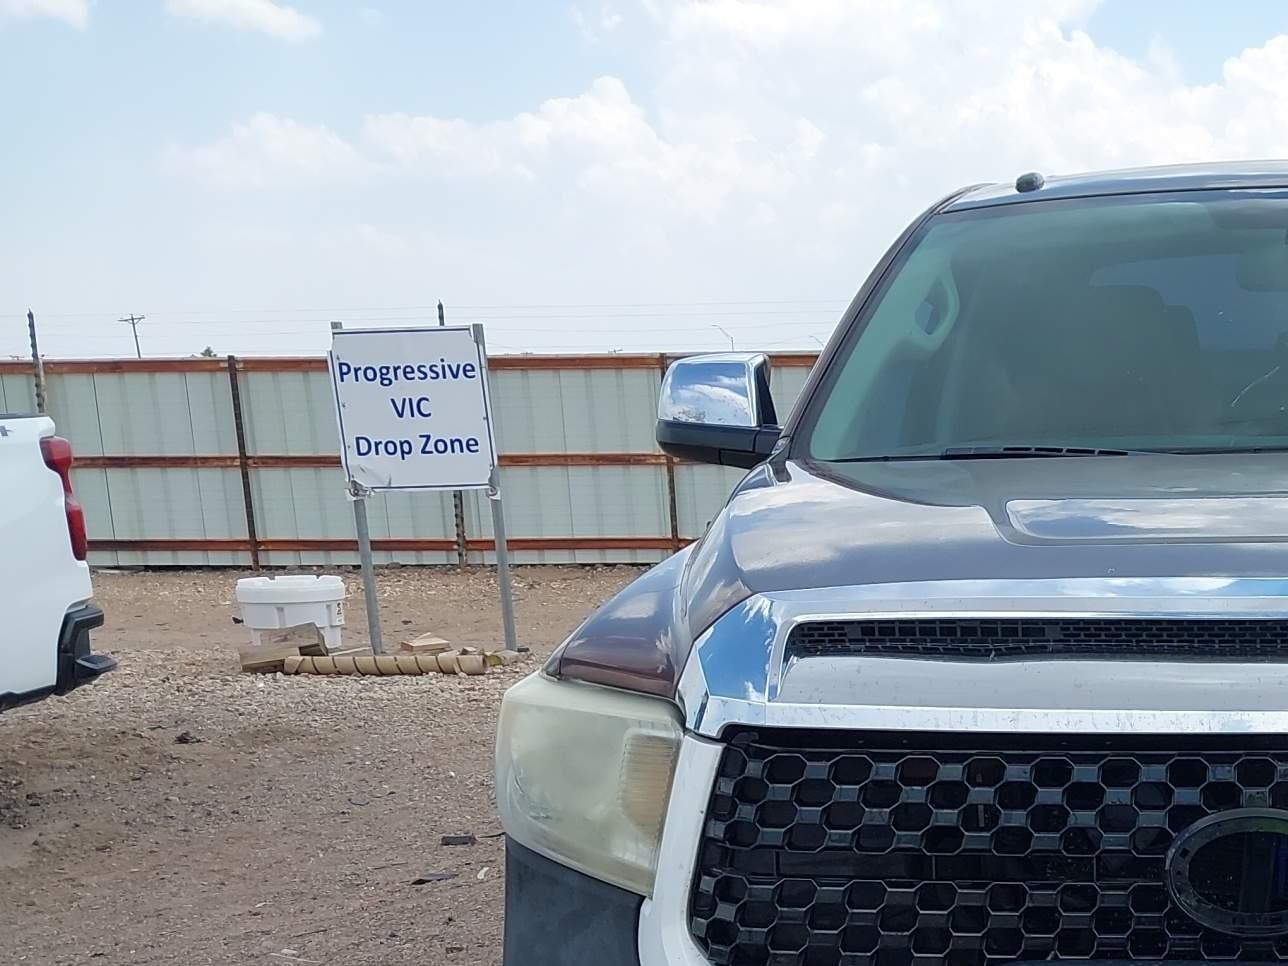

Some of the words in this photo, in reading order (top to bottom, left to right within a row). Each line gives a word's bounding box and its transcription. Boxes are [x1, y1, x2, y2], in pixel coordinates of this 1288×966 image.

[338, 358, 476, 387] Progressive
[390, 397, 432, 418] VIC
[355, 435, 413, 460] Drop
[418, 434, 480, 455] Zone
